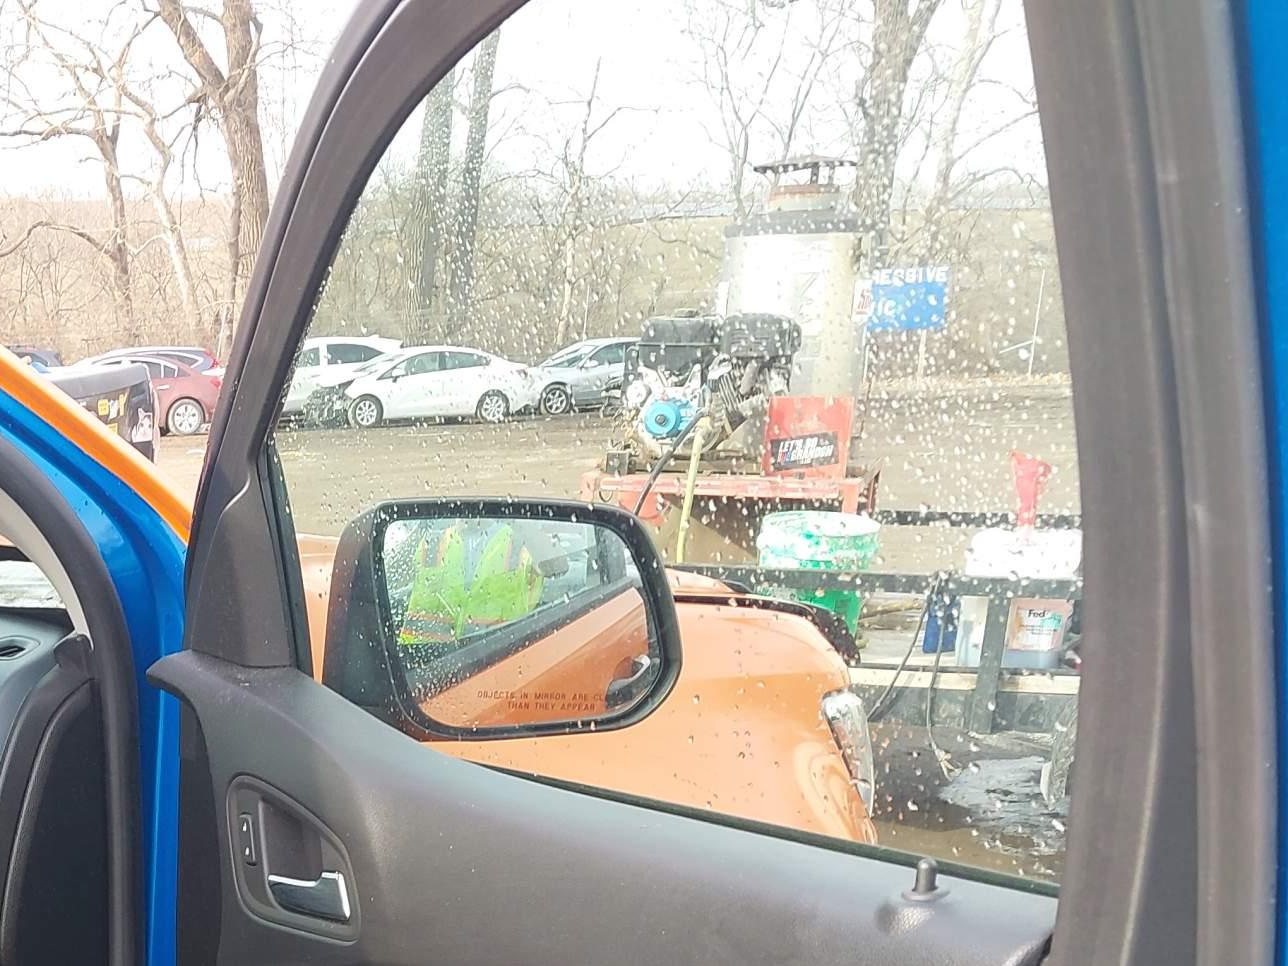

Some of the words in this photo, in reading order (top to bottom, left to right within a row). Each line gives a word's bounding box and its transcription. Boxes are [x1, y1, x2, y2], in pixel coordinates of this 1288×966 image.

[477, 690, 514, 700] OBJECTS
[520, 691, 528, 700] IN
[534, 691, 566, 701] MIRROR
[572, 693, 588, 701] ARE
[507, 702, 530, 711] THAN
[535, 703, 555, 711] THEY
[561, 703, 596, 712] APPEAR
